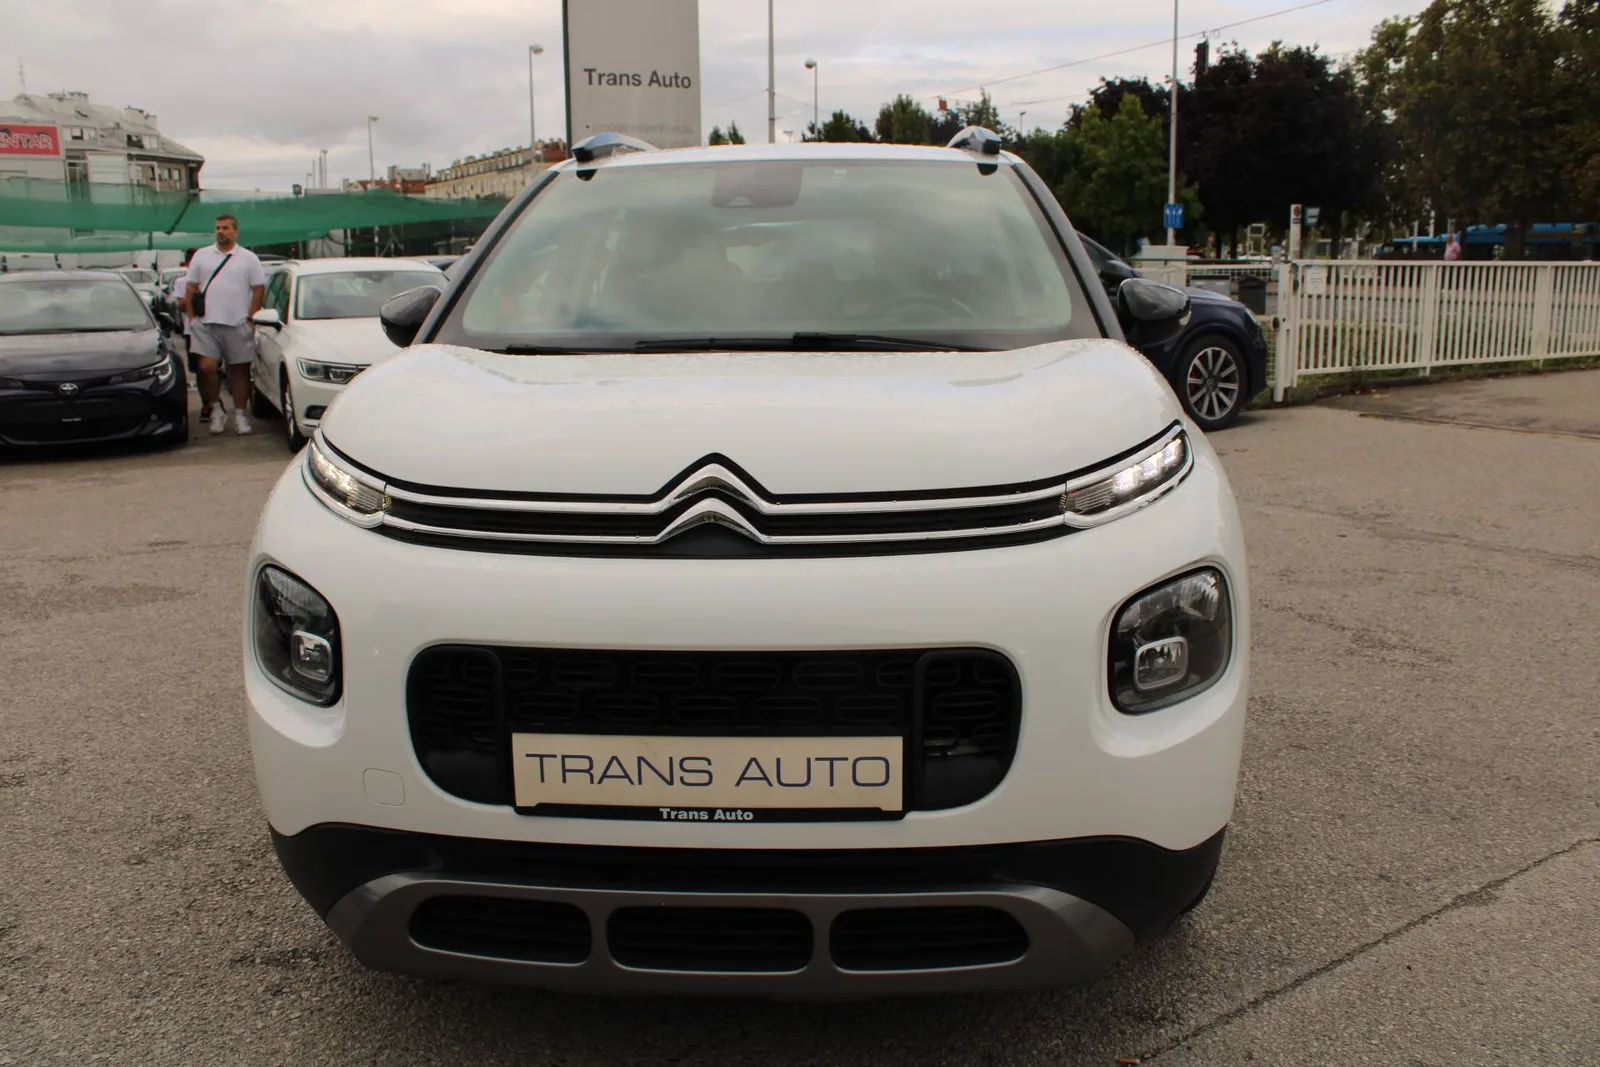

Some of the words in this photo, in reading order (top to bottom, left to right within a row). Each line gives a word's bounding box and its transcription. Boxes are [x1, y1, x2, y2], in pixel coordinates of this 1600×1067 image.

[583, 68, 642, 87] Trans
[648, 70, 692, 89] Auto
[525, 753, 714, 787] TRANS
[734, 756, 890, 788] AUTO
[659, 808, 709, 820] Trans
[713, 809, 754, 820] Auto
